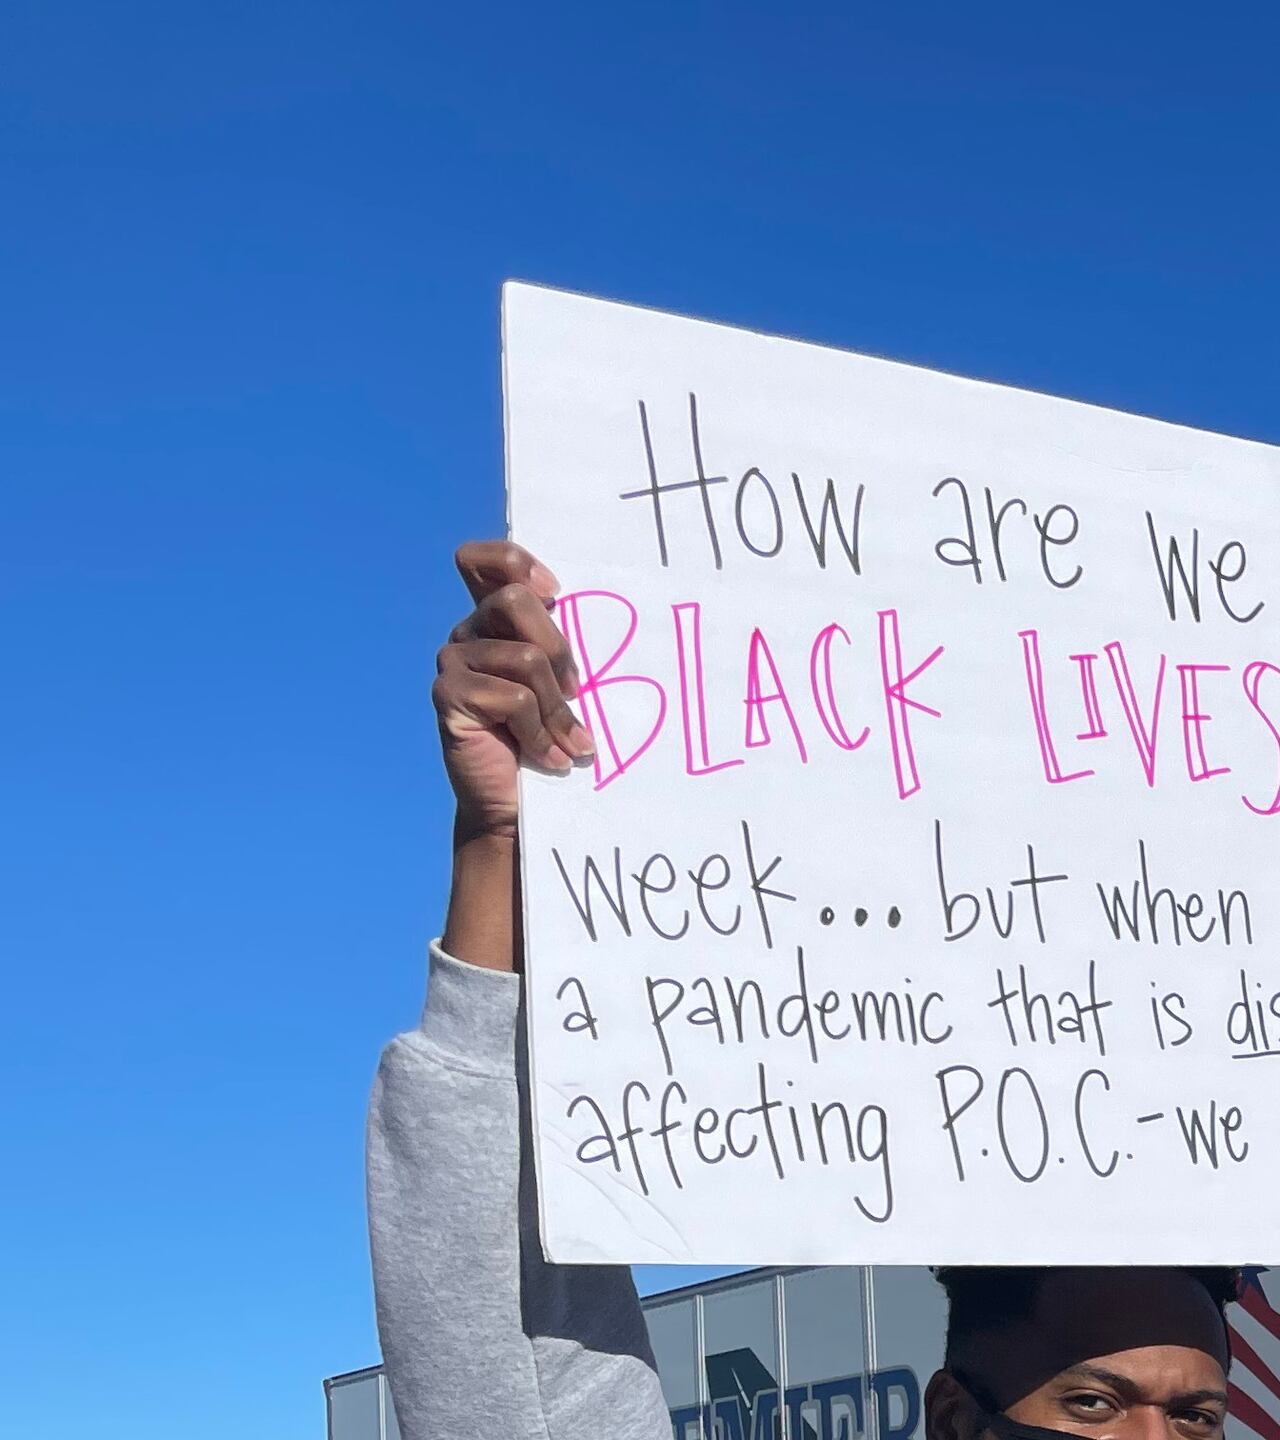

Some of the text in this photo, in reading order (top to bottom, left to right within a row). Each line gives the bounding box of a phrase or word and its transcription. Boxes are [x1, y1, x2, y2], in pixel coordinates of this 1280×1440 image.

[620, 392, 865, 576] How
[932, 478, 1083, 588] are
[1146, 510, 1265, 624] we
[547, 590, 945, 800] BLACK
[552, 820, 902, 948] week...
[935, 819, 1069, 943] but
[1096, 839, 1253, 946] when
[557, 978, 599, 1041] a
[645, 945, 953, 1076] pandemic
[987, 959, 1113, 1057] that
[1151, 981, 1194, 1051] is
[567, 1062, 894, 1223] affecting
